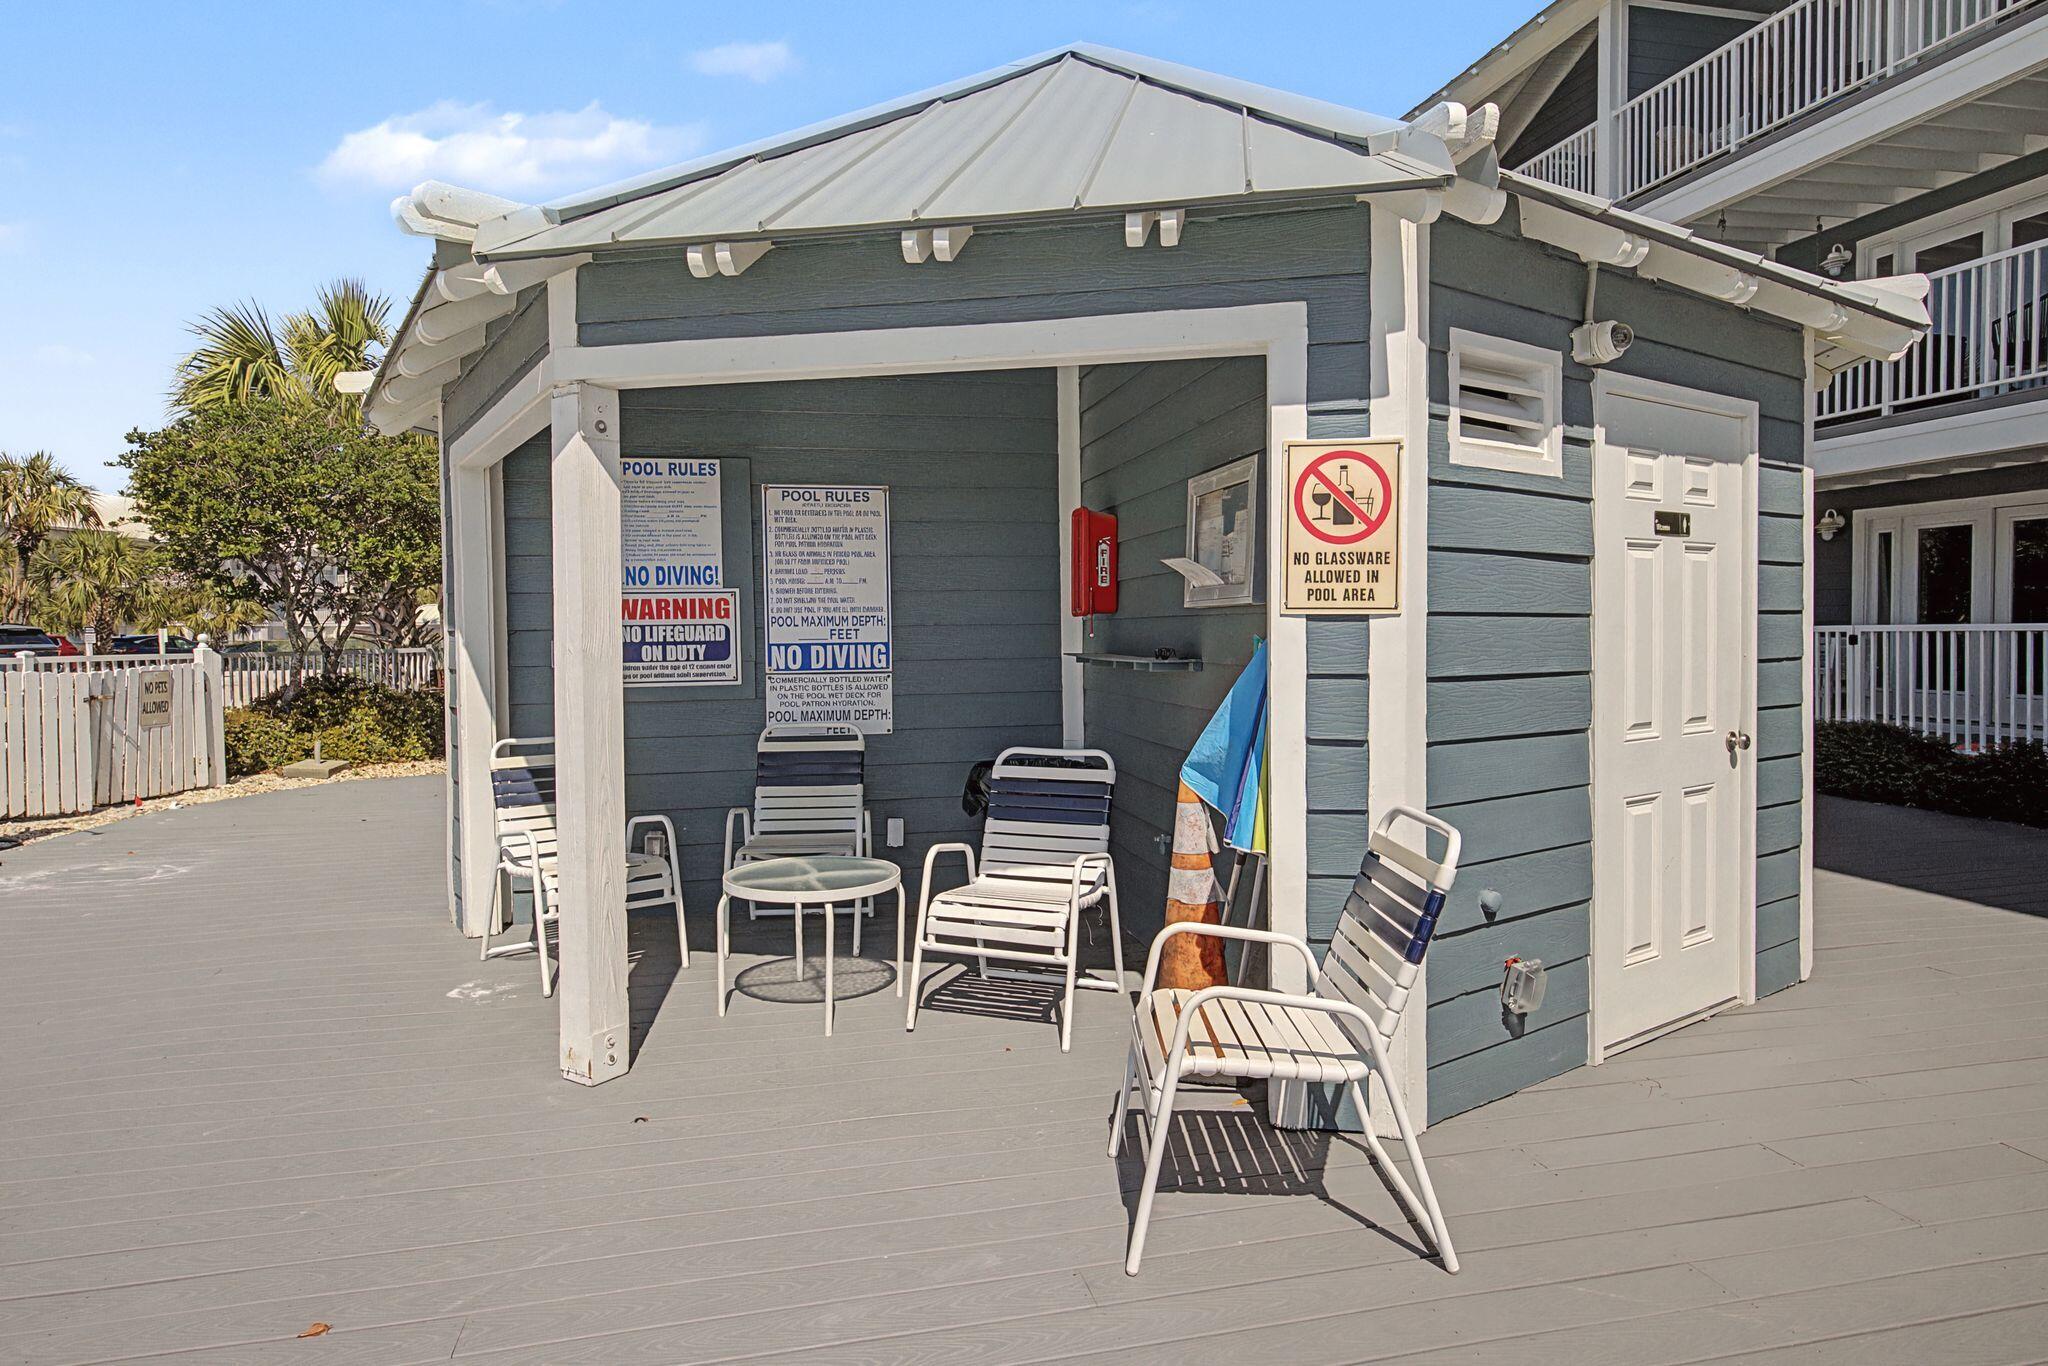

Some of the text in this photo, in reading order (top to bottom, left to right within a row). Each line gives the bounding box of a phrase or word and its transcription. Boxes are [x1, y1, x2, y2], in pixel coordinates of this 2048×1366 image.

[622, 462, 716, 476] POOL RULES
[782, 490, 870, 502] POOL RULES
[1294, 552, 1390, 565] NO GLASSWARE
[626, 566, 718, 586] NO DIVING!
[1305, 570, 1379, 583] ALLOWED IN
[1308, 588, 1375, 601] POOL AREA
[622, 598, 730, 620] WARNING
[771, 615, 886, 627] POOL MAXIMUM DEPTH:
[623, 625, 726, 642] NO LIFEGUARD
[830, 629, 860, 639] FEET
[641, 644, 706, 661] ON DUTY
[771, 644, 886, 670] NO DIVING
[145, 681, 168, 694] NO PETS
[143, 701, 169, 714] ALLOWED
[768, 709, 891, 722] POOL MAXIMUM DEPTH:
